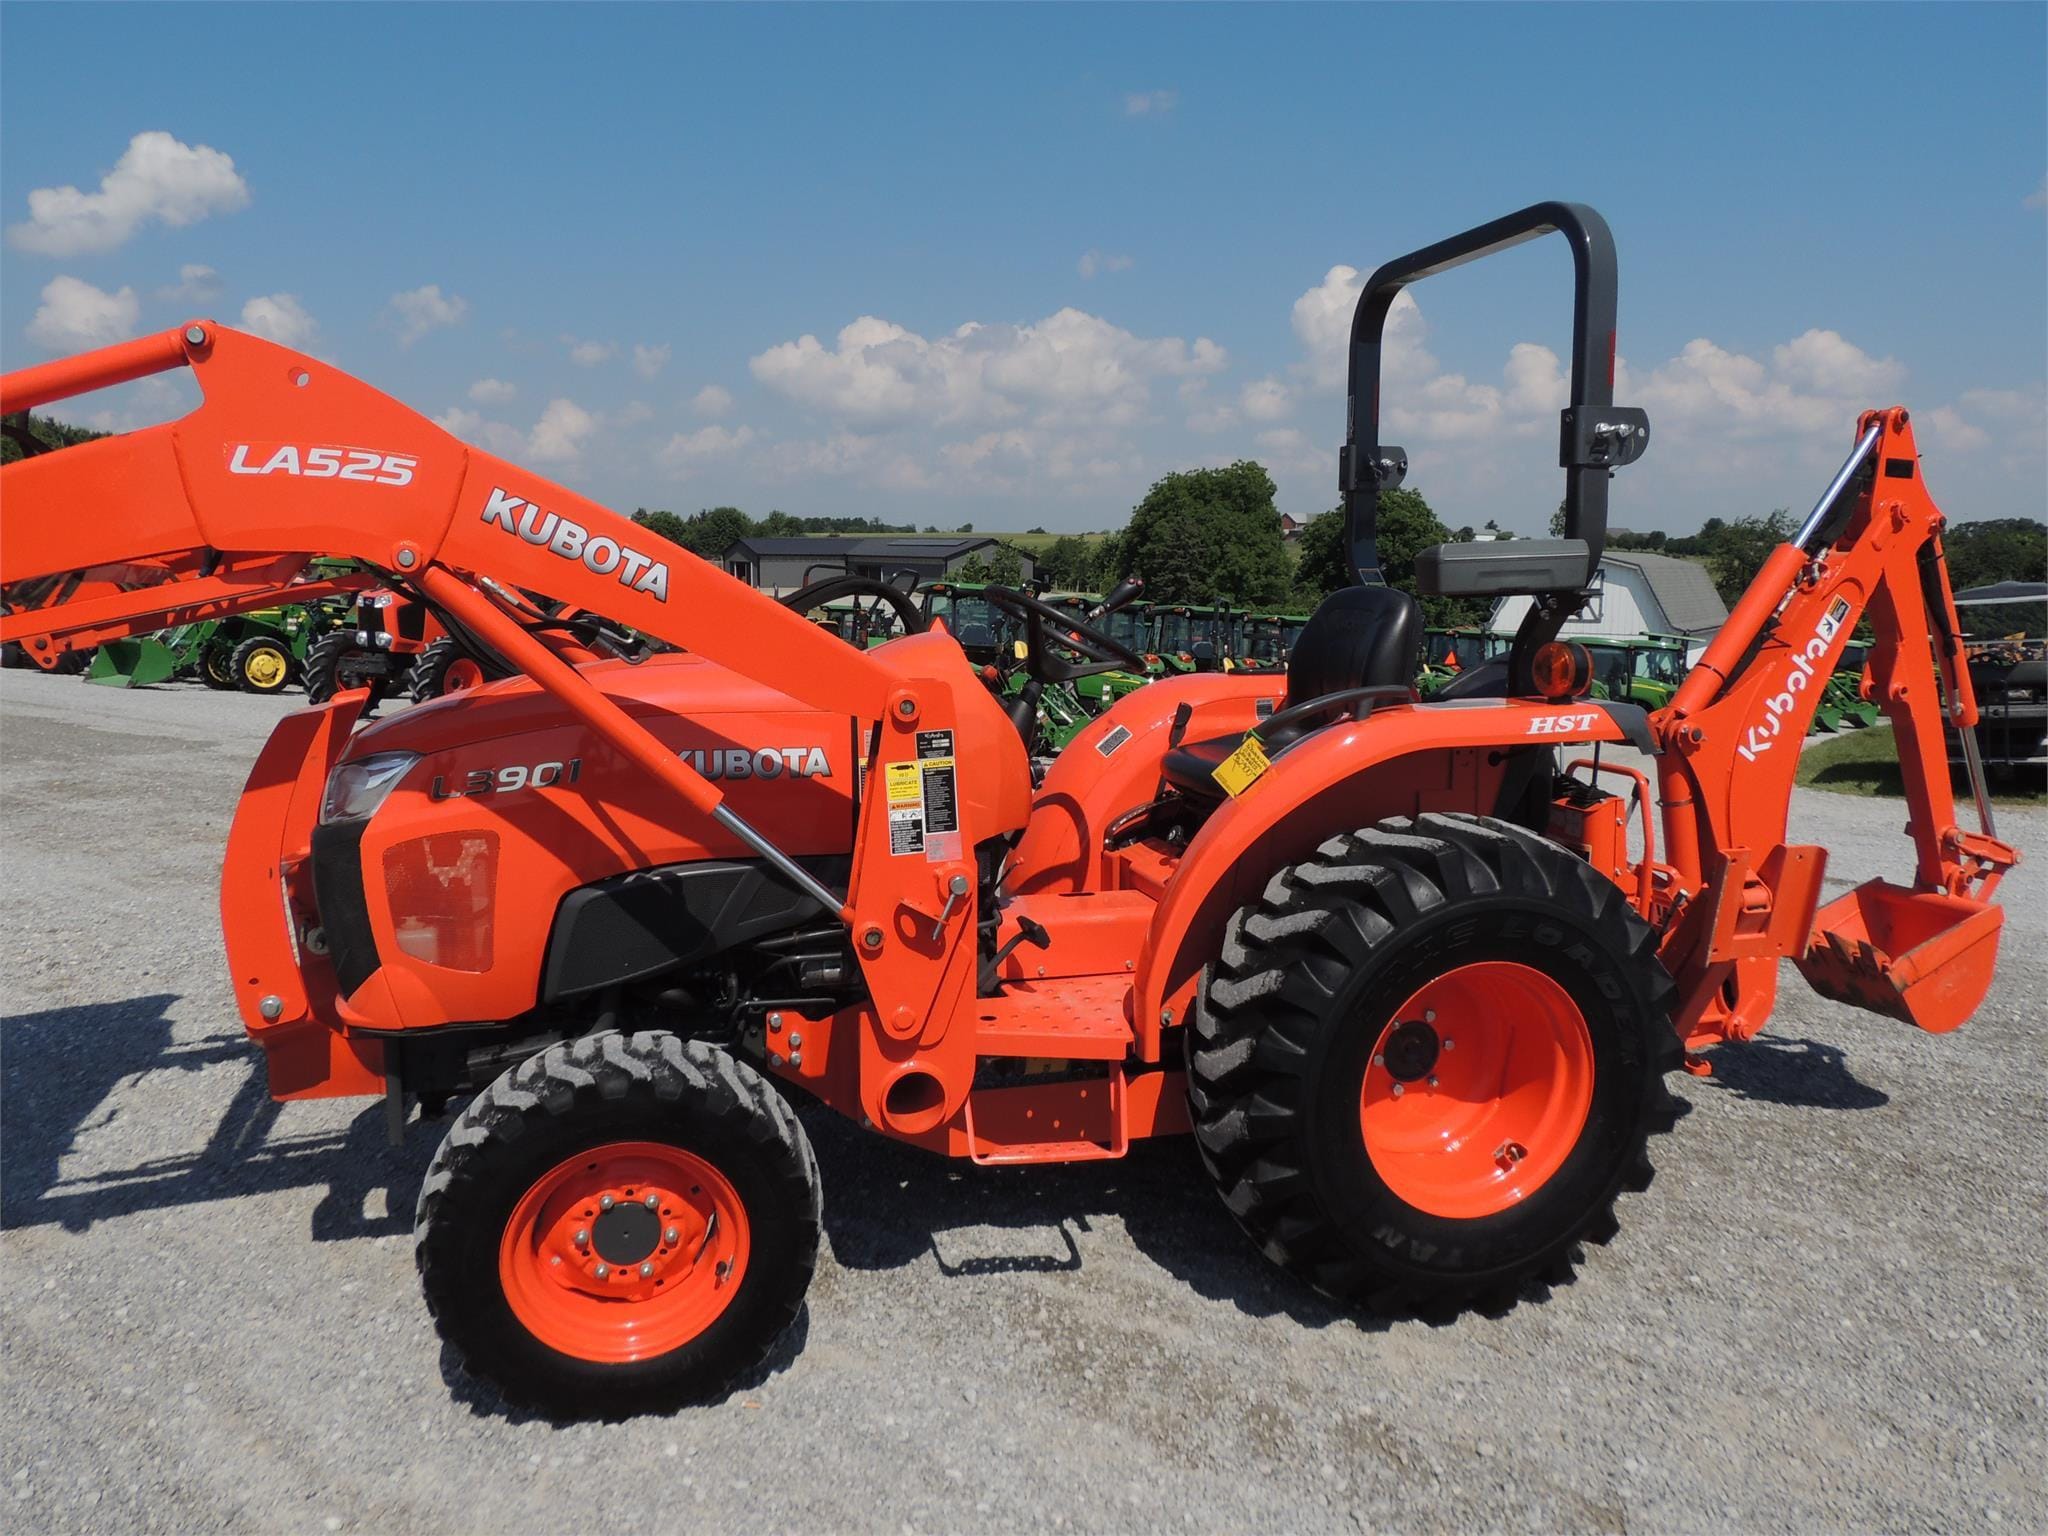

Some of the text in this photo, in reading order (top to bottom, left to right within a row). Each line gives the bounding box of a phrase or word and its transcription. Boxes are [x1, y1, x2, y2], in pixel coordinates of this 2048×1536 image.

[229, 443, 417, 486] LA525
[480, 487, 669, 603] KUBOTA
[1737, 636, 1831, 763] Kubota
[1526, 714, 1599, 735] HST
[431, 758, 583, 799] L3901
[677, 747, 833, 780] UBOTA
